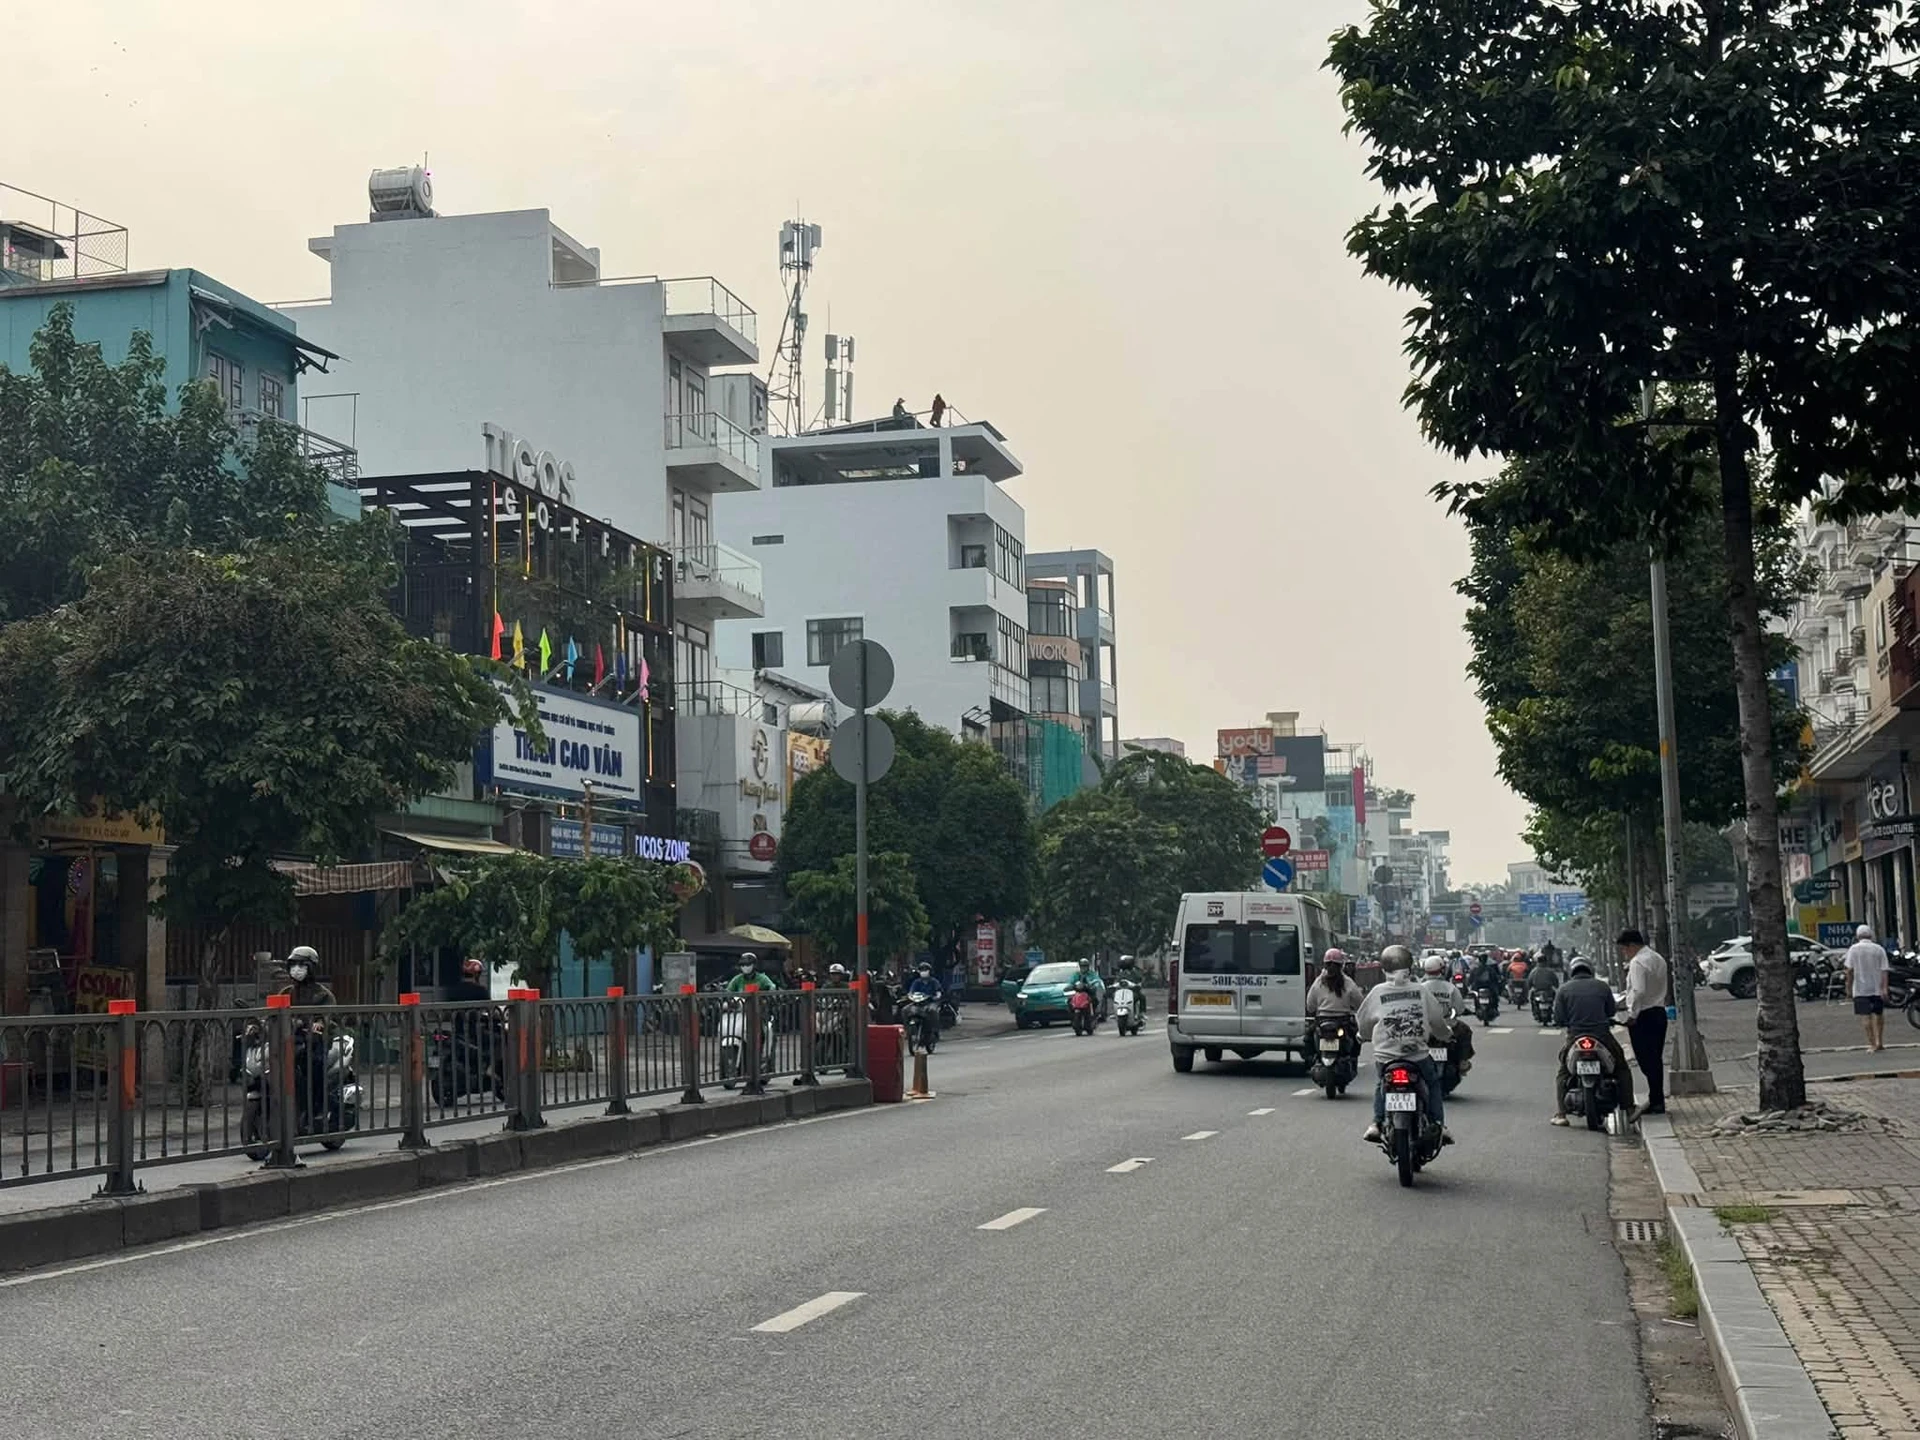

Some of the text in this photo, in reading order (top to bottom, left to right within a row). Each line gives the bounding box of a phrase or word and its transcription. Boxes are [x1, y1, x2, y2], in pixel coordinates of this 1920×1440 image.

[481, 422, 576, 506] TICOS
[1220, 730, 1270, 755] yody
[560, 739, 590, 771] CAO
[594, 743, 622, 778] VÂN
[635, 834, 663, 860] TICOS
[664, 839, 691, 861] ZONE
[1827, 925, 1854, 936] NHA
